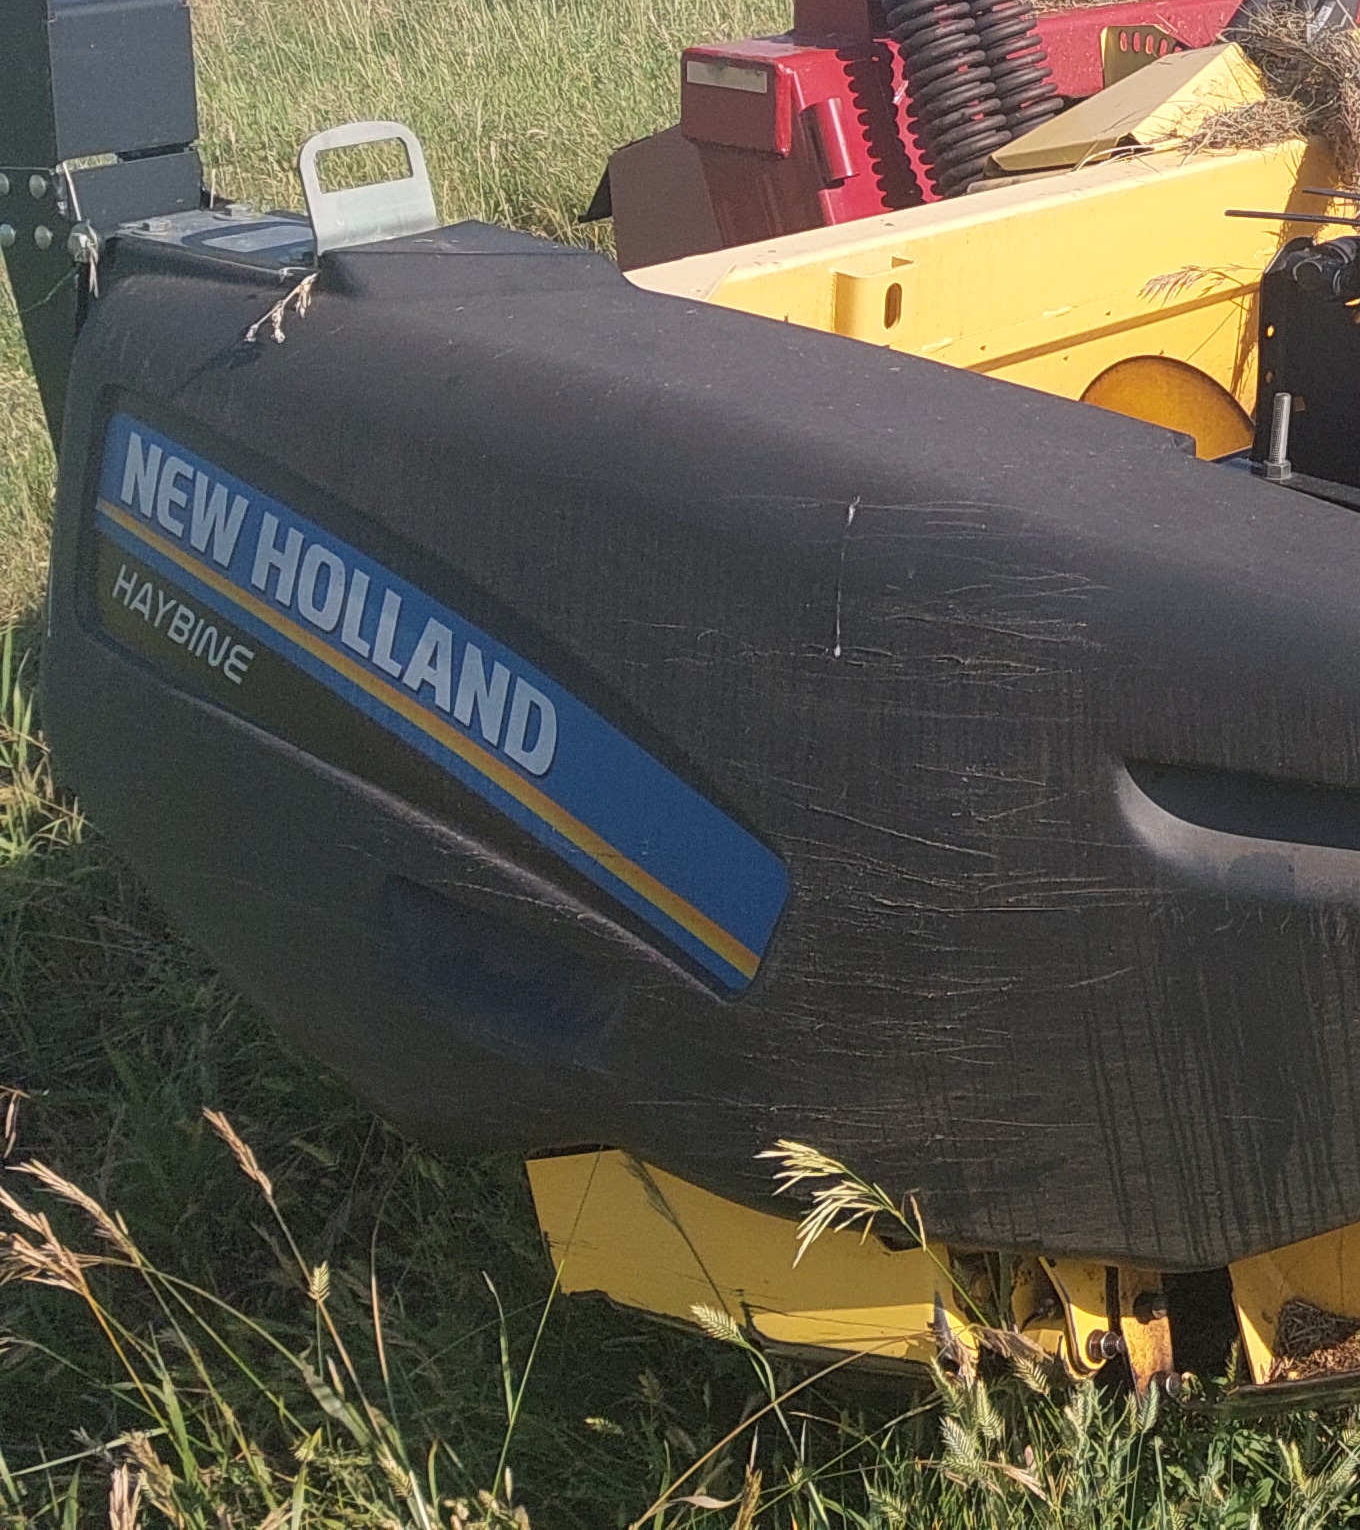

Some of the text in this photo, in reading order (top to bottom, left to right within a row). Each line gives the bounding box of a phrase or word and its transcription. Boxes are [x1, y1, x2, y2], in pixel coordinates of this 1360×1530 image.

[112, 563, 255, 686] HAYBINE
[121, 432, 559, 778] NEW HOLLAND
